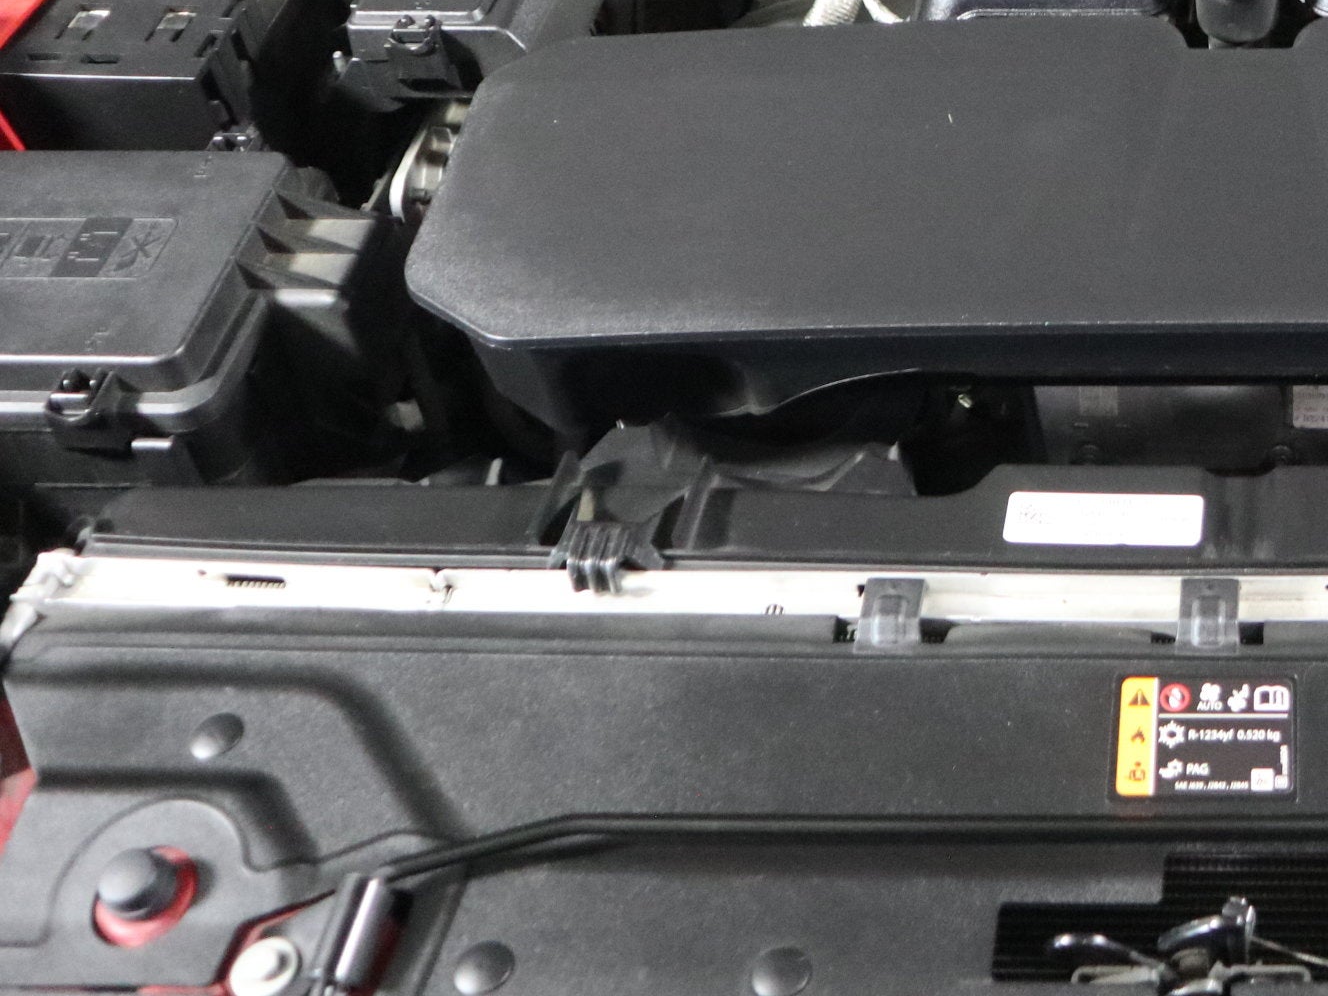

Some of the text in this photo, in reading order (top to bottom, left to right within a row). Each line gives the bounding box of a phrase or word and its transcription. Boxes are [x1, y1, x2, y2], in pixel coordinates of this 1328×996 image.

[1197, 701, 1223, 711] AUTO
[1188, 728, 1235, 743] R-1234yf
[1267, 728, 1281, 743] kg
[1186, 763, 1209, 776] PAG
